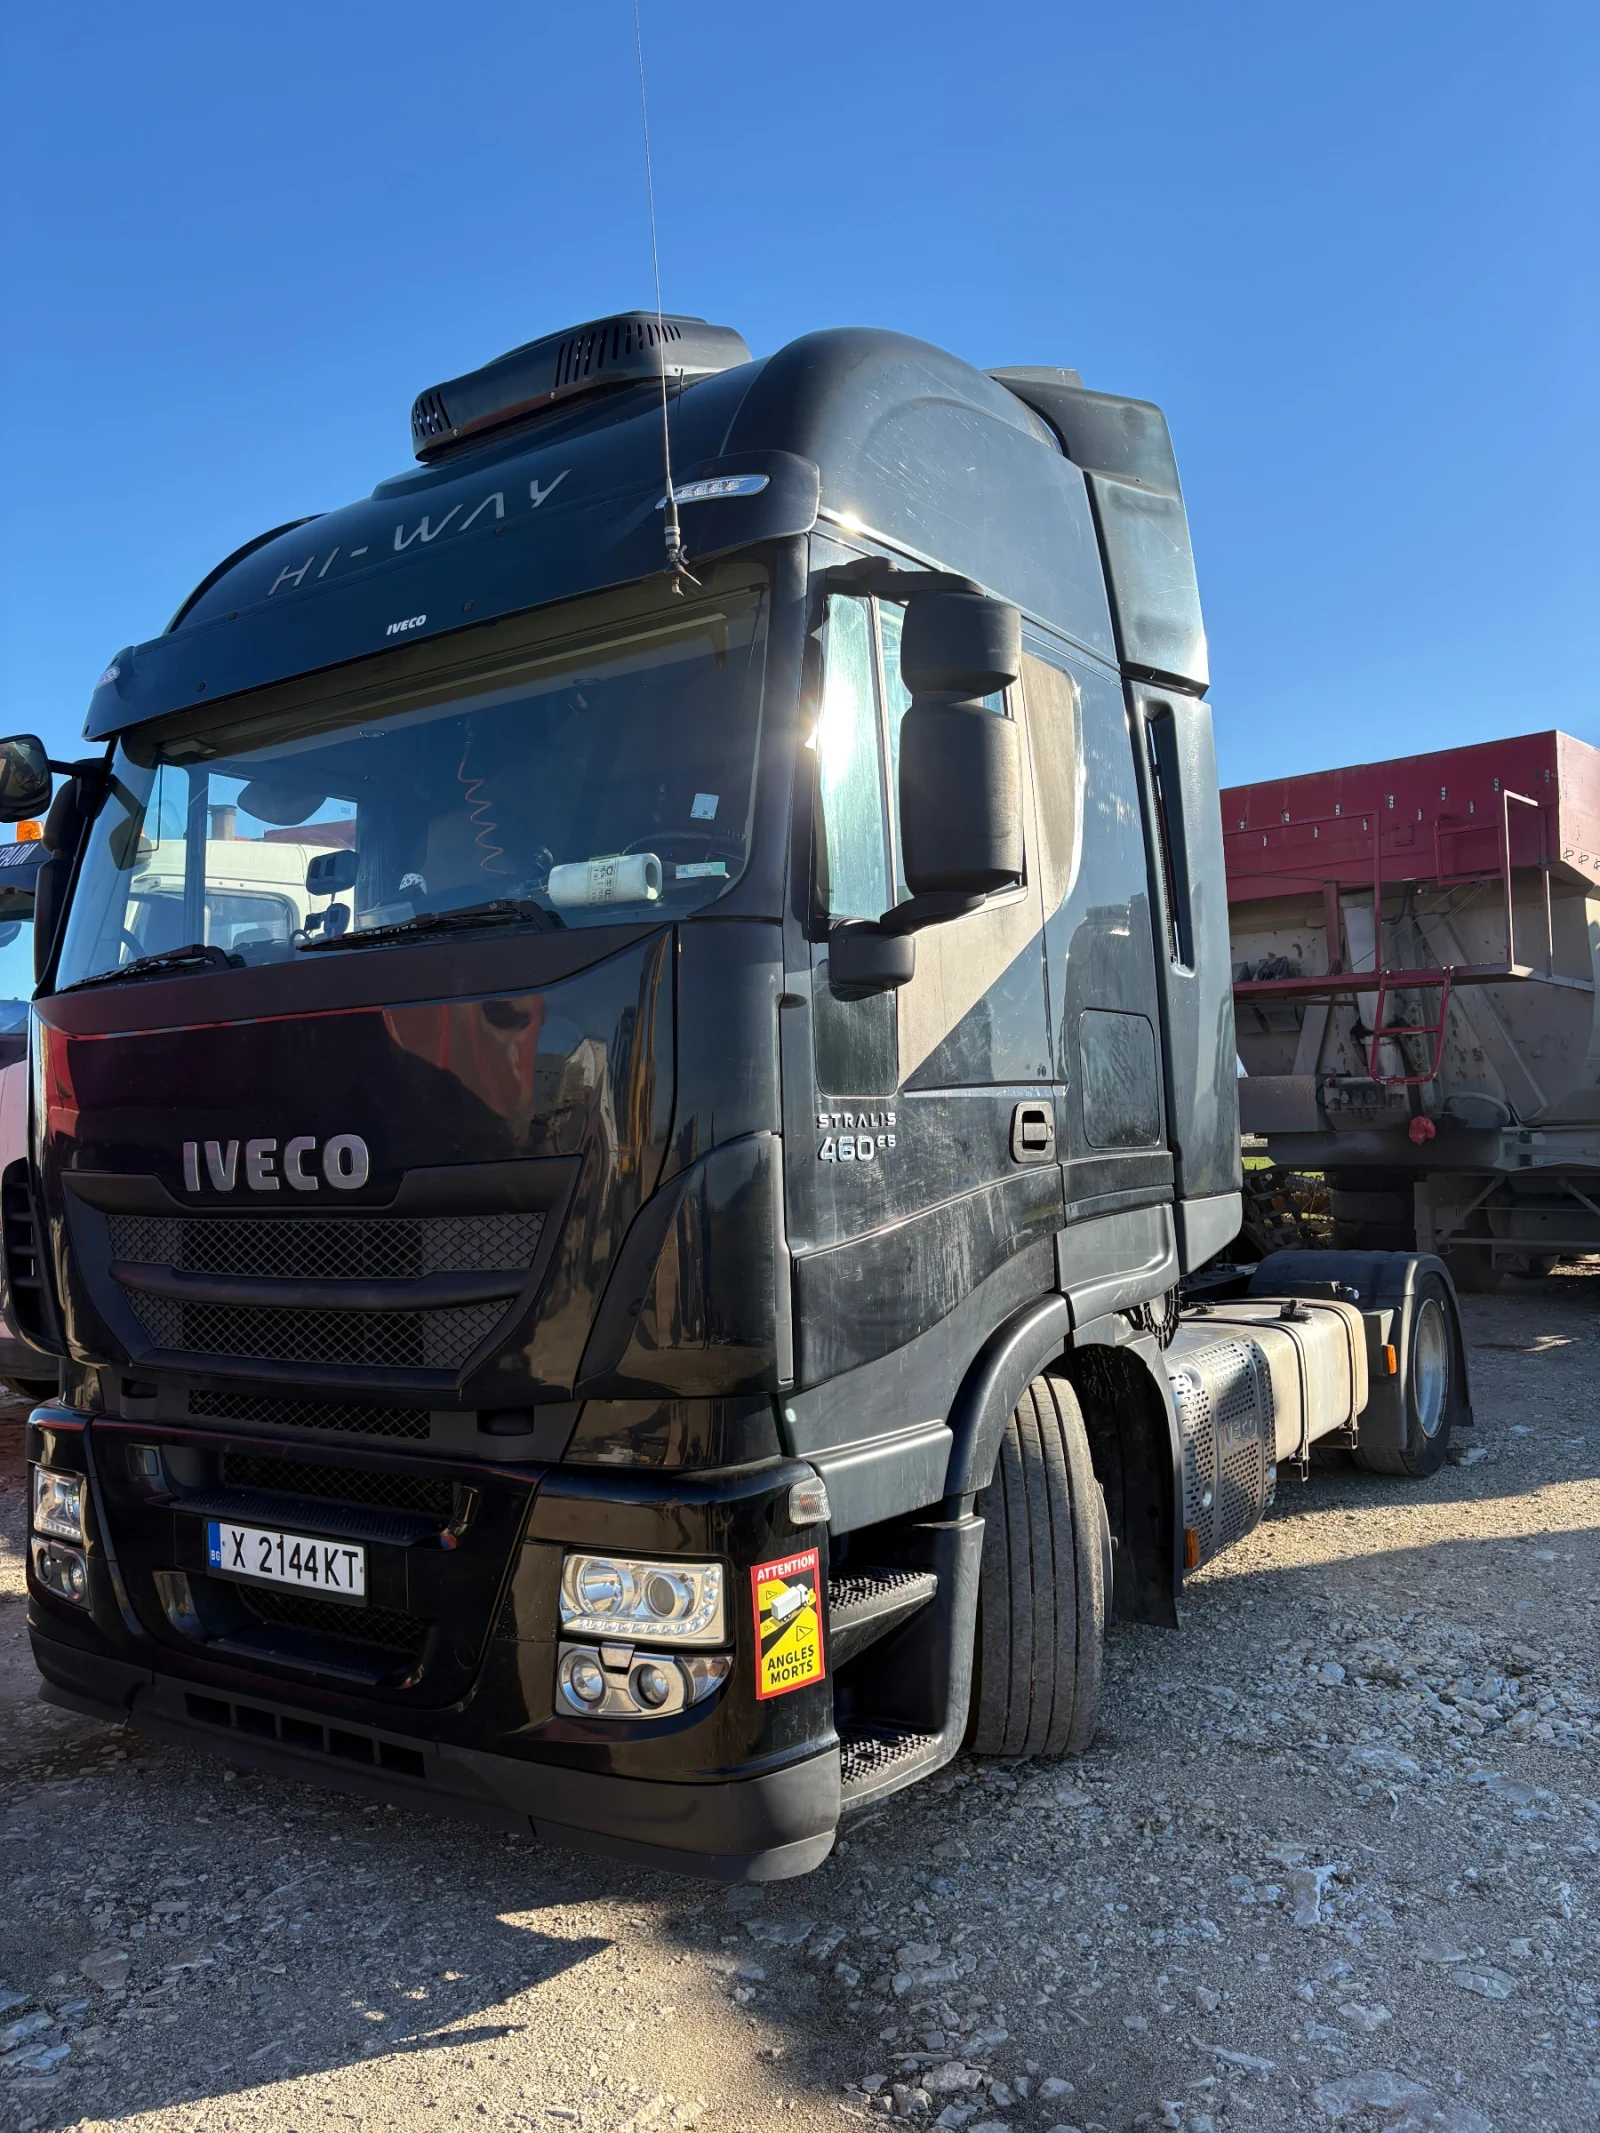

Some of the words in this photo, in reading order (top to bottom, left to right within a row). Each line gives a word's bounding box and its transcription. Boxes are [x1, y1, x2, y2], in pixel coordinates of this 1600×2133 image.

[386, 614, 427, 635] IVECO
[816, 1112, 896, 1129] STRALIS
[183, 1134, 369, 1192] IVECO
[1220, 1414, 1257, 1453] IVECO
[210, 1549, 221, 1561] BG
[757, 1553, 815, 1581] ATTENTION
[767, 1644, 814, 1671] ANGLES
[770, 1659, 813, 1685] MORTS
